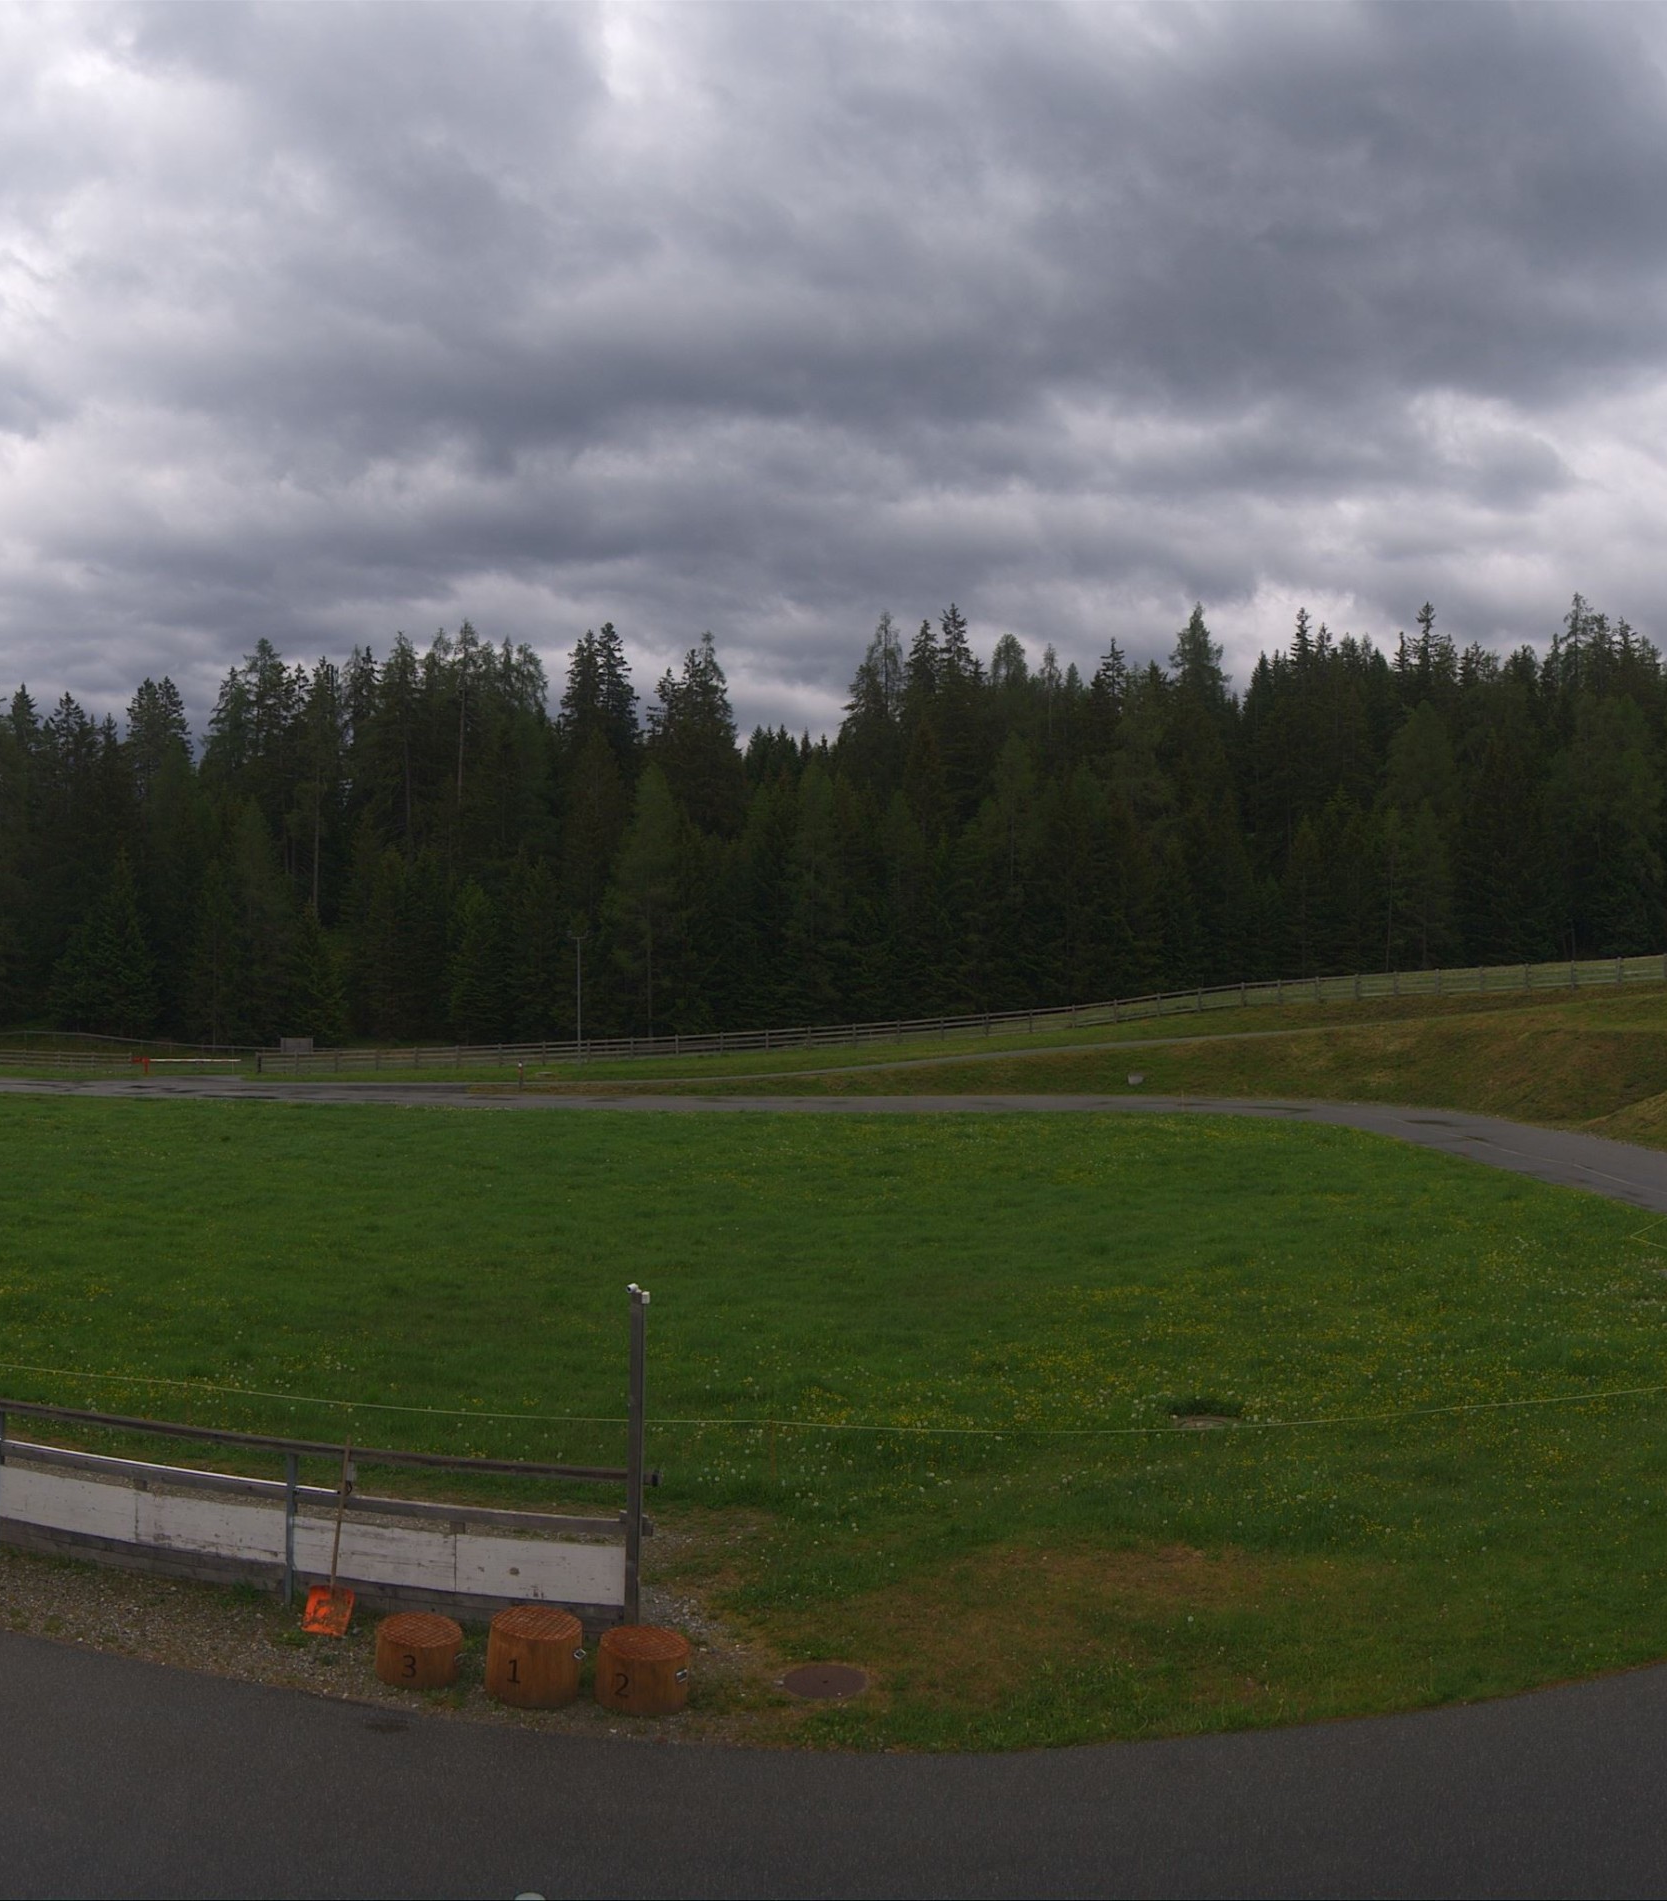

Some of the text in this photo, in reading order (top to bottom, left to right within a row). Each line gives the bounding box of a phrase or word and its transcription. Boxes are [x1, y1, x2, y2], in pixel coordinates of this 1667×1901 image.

[400, 1654, 418, 1679] 3
[506, 1658, 522, 1685] 1
[613, 1672, 630, 1699] 2
